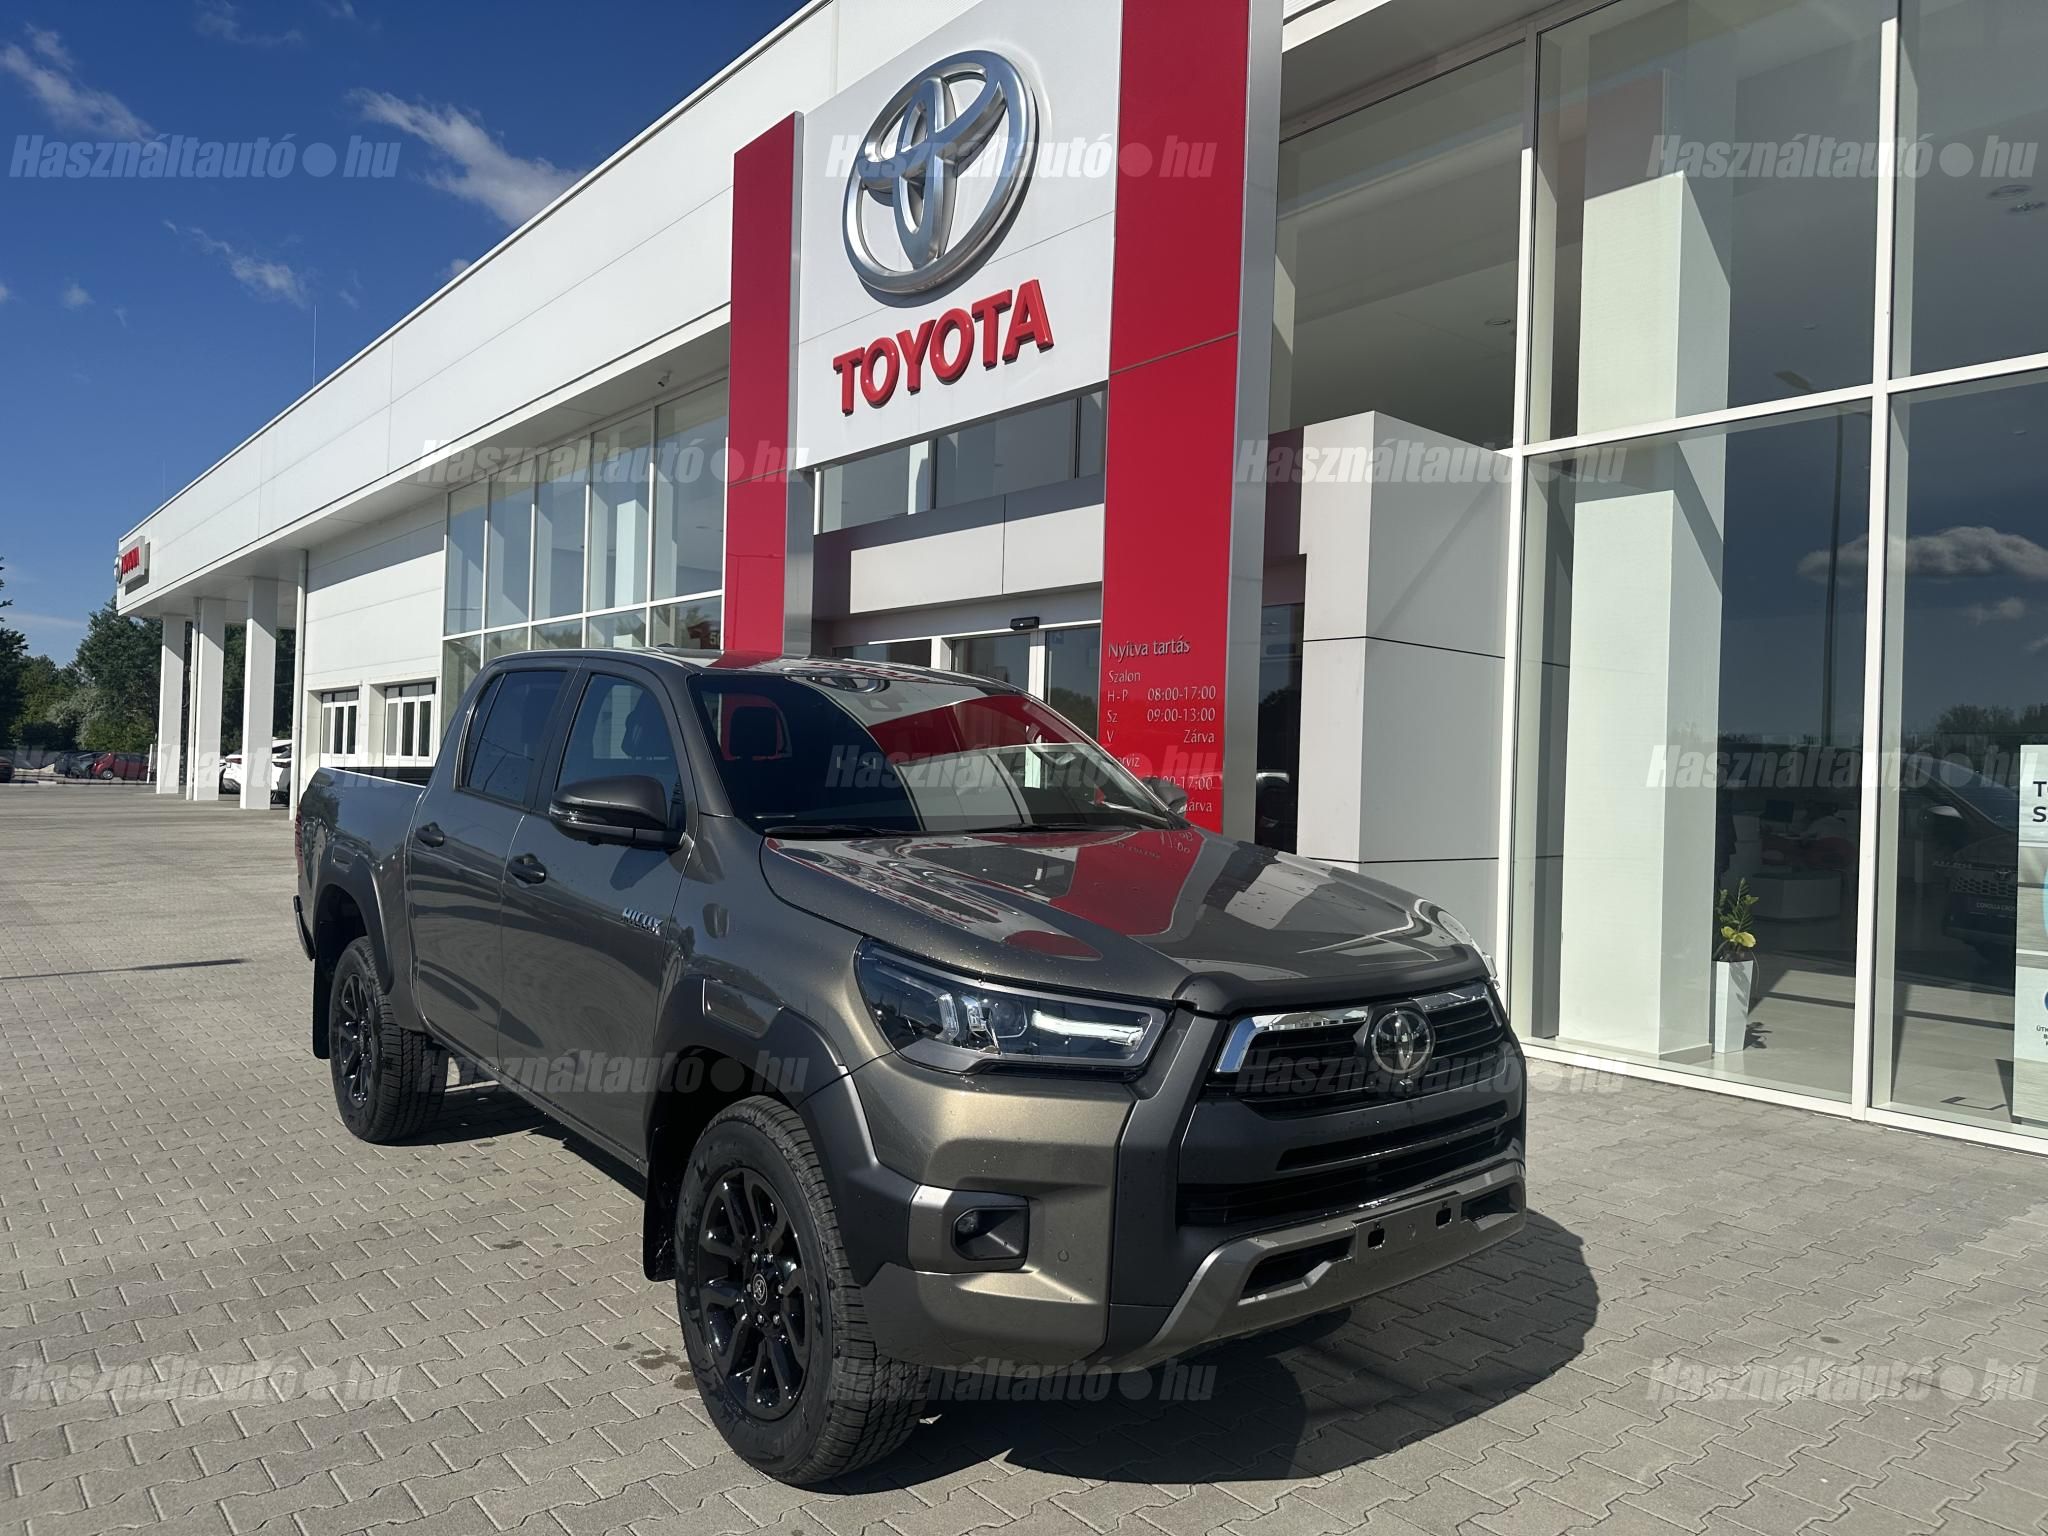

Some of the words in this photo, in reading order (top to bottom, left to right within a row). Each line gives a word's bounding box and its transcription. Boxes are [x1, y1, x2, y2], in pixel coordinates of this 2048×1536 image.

[832, 278, 1055, 417] TOYOTA
[1108, 641, 1149, 663] Nyitva
[1153, 635, 1191, 656] tartás
[1108, 669, 1141, 683] Szalon
[1147, 685, 1216, 701] 08:00-17:00
[1107, 709, 1118, 723] Sz
[1147, 707, 1216, 722] 09:00-13:00
[1107, 730, 1114, 743] V
[1183, 729, 1215, 744] Zárva
[1186, 798, 1213, 812] árva
